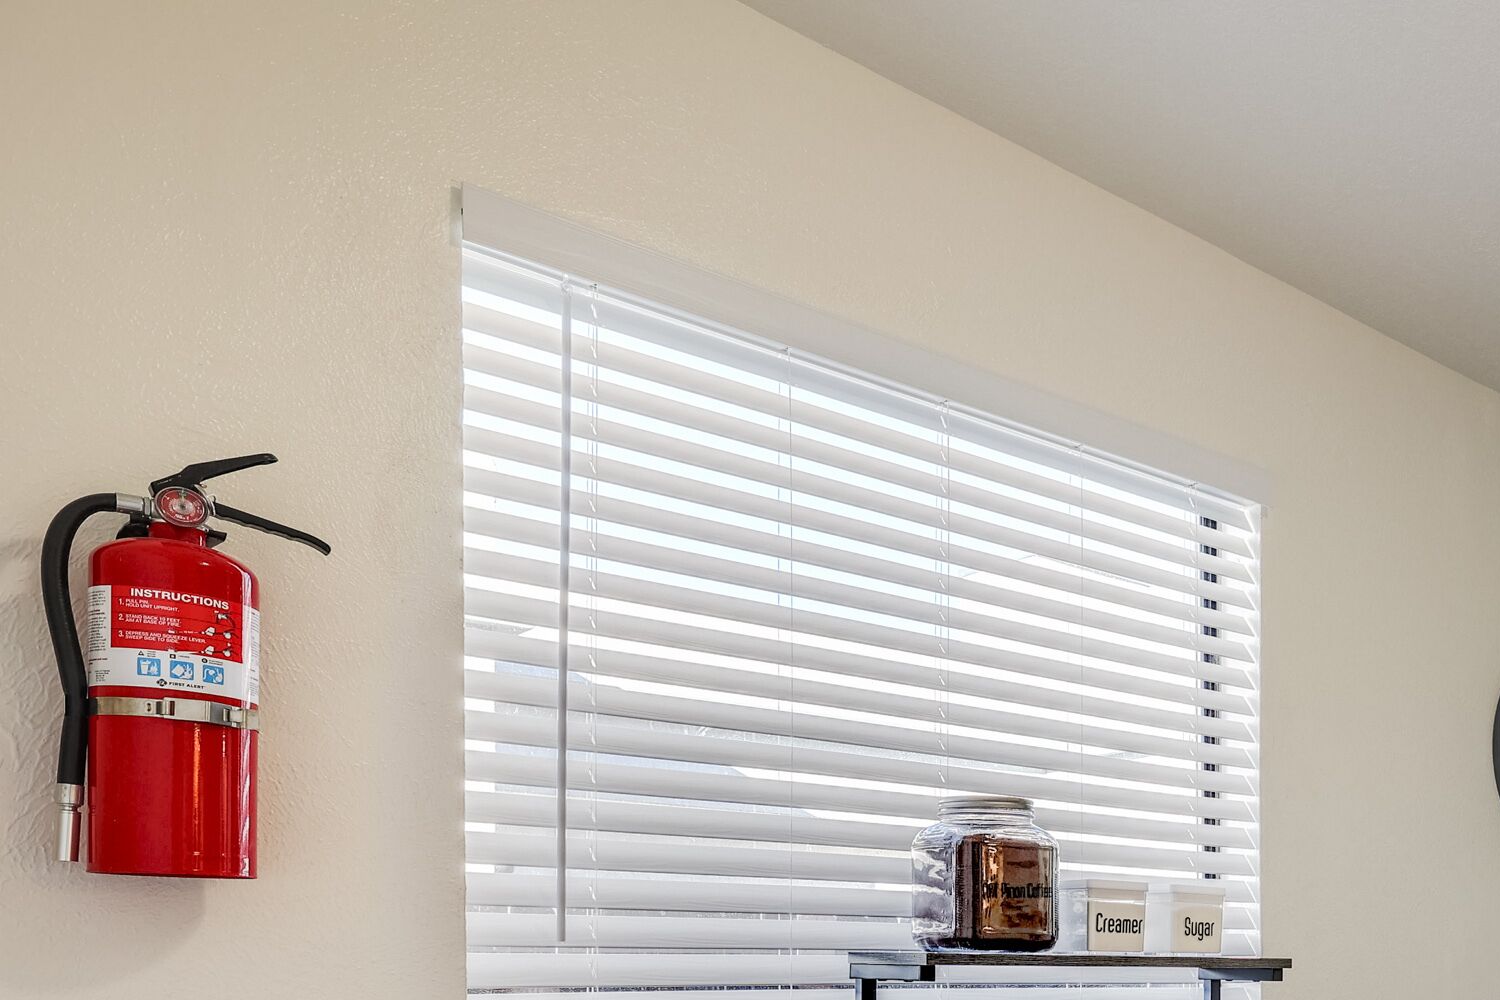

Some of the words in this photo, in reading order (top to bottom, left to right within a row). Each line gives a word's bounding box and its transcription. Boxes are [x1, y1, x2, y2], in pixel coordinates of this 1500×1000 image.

[130, 587, 229, 610] INSTRUCTIONS
[1095, 912, 1143, 934] Creamer
[1184, 916, 1215, 941] Sugar
